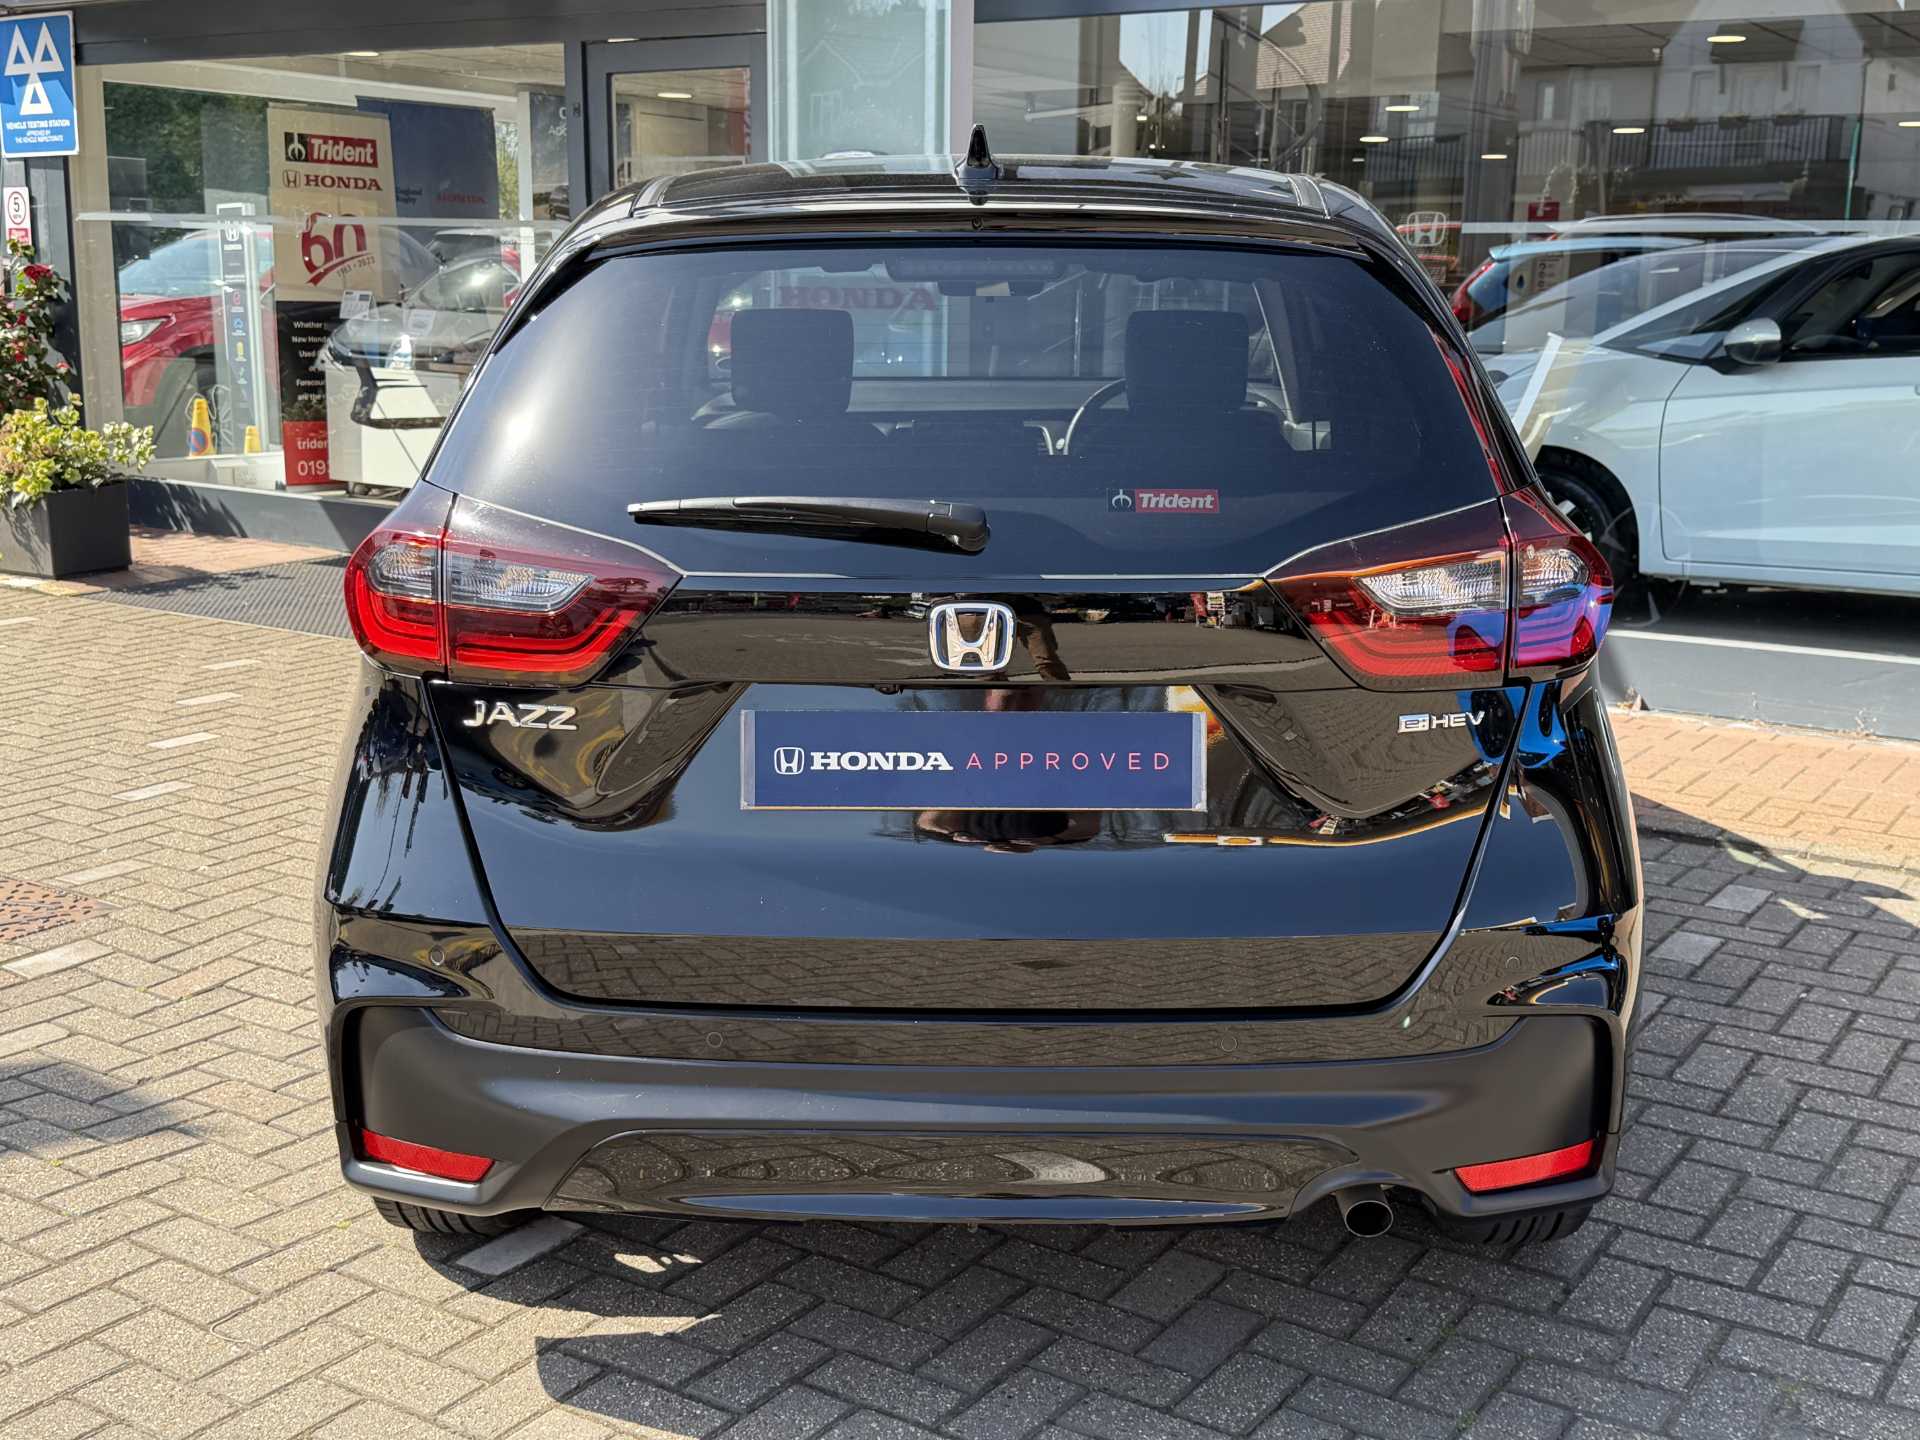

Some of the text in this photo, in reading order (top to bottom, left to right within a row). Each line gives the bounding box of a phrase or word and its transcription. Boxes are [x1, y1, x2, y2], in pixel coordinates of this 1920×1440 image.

[311, 137, 374, 164] Trident
[304, 174, 383, 192] HONDA
[13, 196, 20, 213] 5
[776, 287, 937, 311] HONDA
[292, 321, 323, 330] Whether
[291, 335, 307, 343] New
[298, 350, 316, 358] Used
[296, 378, 325, 387] Forecou
[298, 460, 328, 476] 019
[1139, 493, 1215, 509] Trident
[463, 700, 577, 731] JAZZ
[810, 751, 1170, 771] HONDA APPROVED
